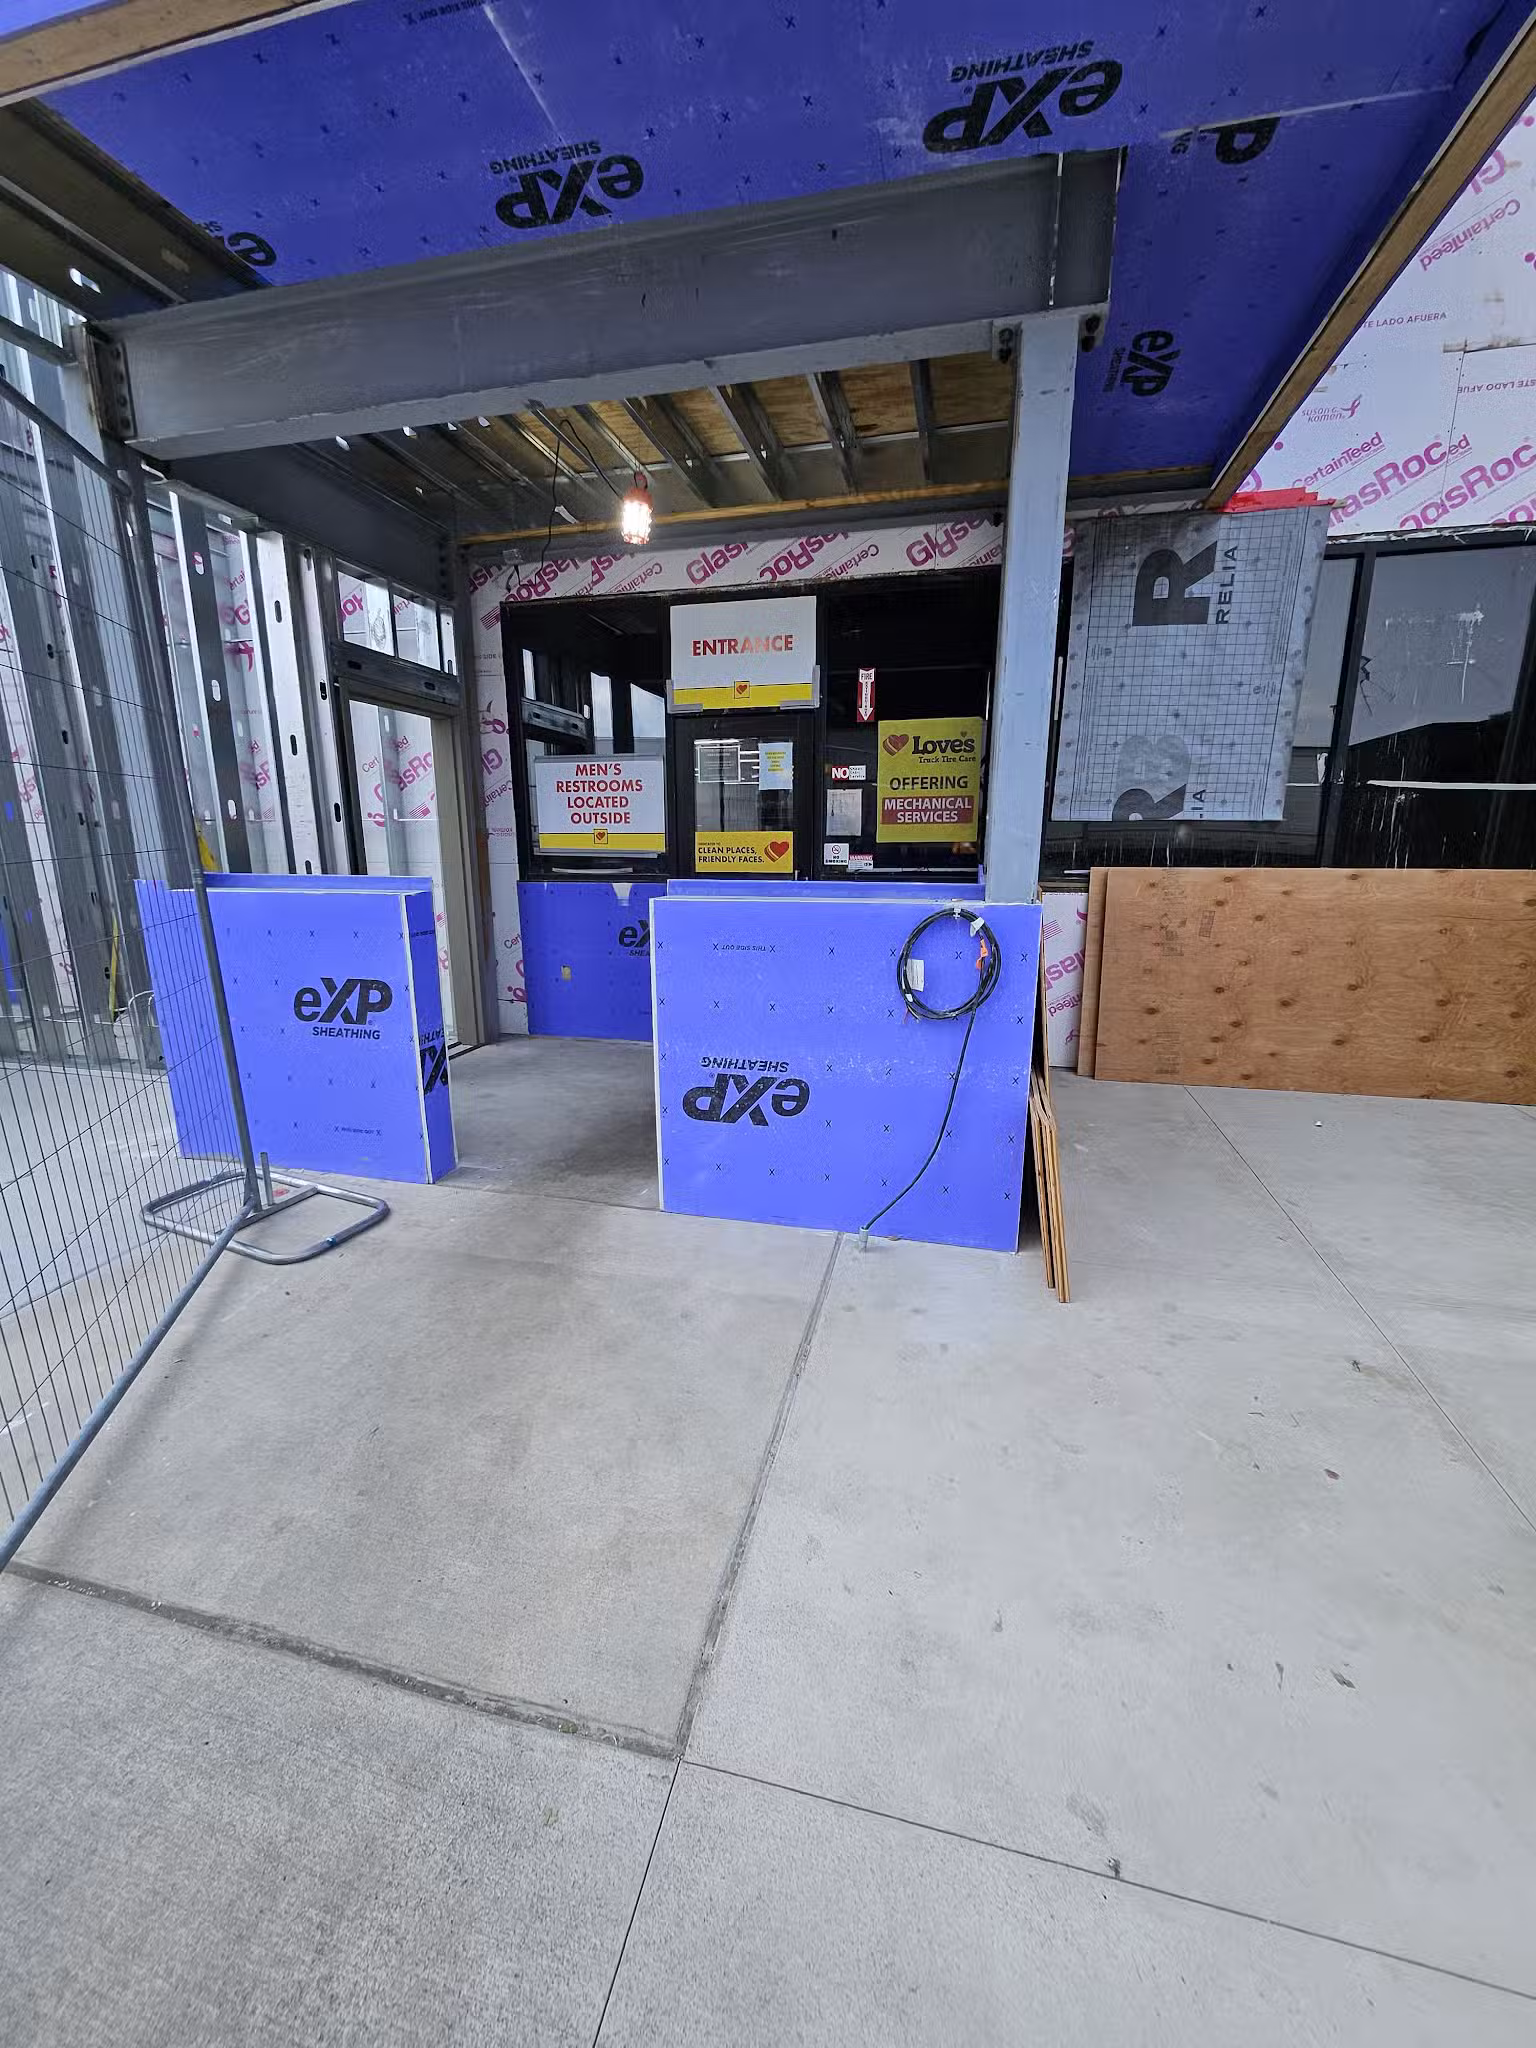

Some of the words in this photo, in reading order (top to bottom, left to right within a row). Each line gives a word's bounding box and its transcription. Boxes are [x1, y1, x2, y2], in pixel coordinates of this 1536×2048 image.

[950, 40, 1095, 83] SHEATHING
[489, 141, 602, 175] SHEATHING
[1419, 198, 1521, 272] CertainTeed
[1377, 316, 1404, 328] LADO
[1406, 311, 1448, 324] AFUERA
[1486, 381, 1516, 392] LADO
[1215, 545, 1239, 625] RELIA
[692, 634, 794, 657] ENTRANCE
[860, 673, 873, 681] FIRE
[959, 755, 977, 763] Care
[575, 763, 622, 777] MEN'S
[831, 767, 850, 780] NO
[556, 779, 644, 793] RESTROOMS
[889, 775, 969, 791] OFFERING
[567, 796, 629, 809] LOCATED
[884, 797, 972, 811] MECHANICAL
[570, 811, 631, 825] OUTSIDE
[896, 811, 959, 823] SERVICES
[726, 846, 757, 855] PLACES,
[698, 855, 736, 863] FRIENDLY
[738, 855, 765, 863] FACES.
[312, 1026, 381, 1040] SHEATHING
[701, 1056, 790, 1073] SHEATHING
